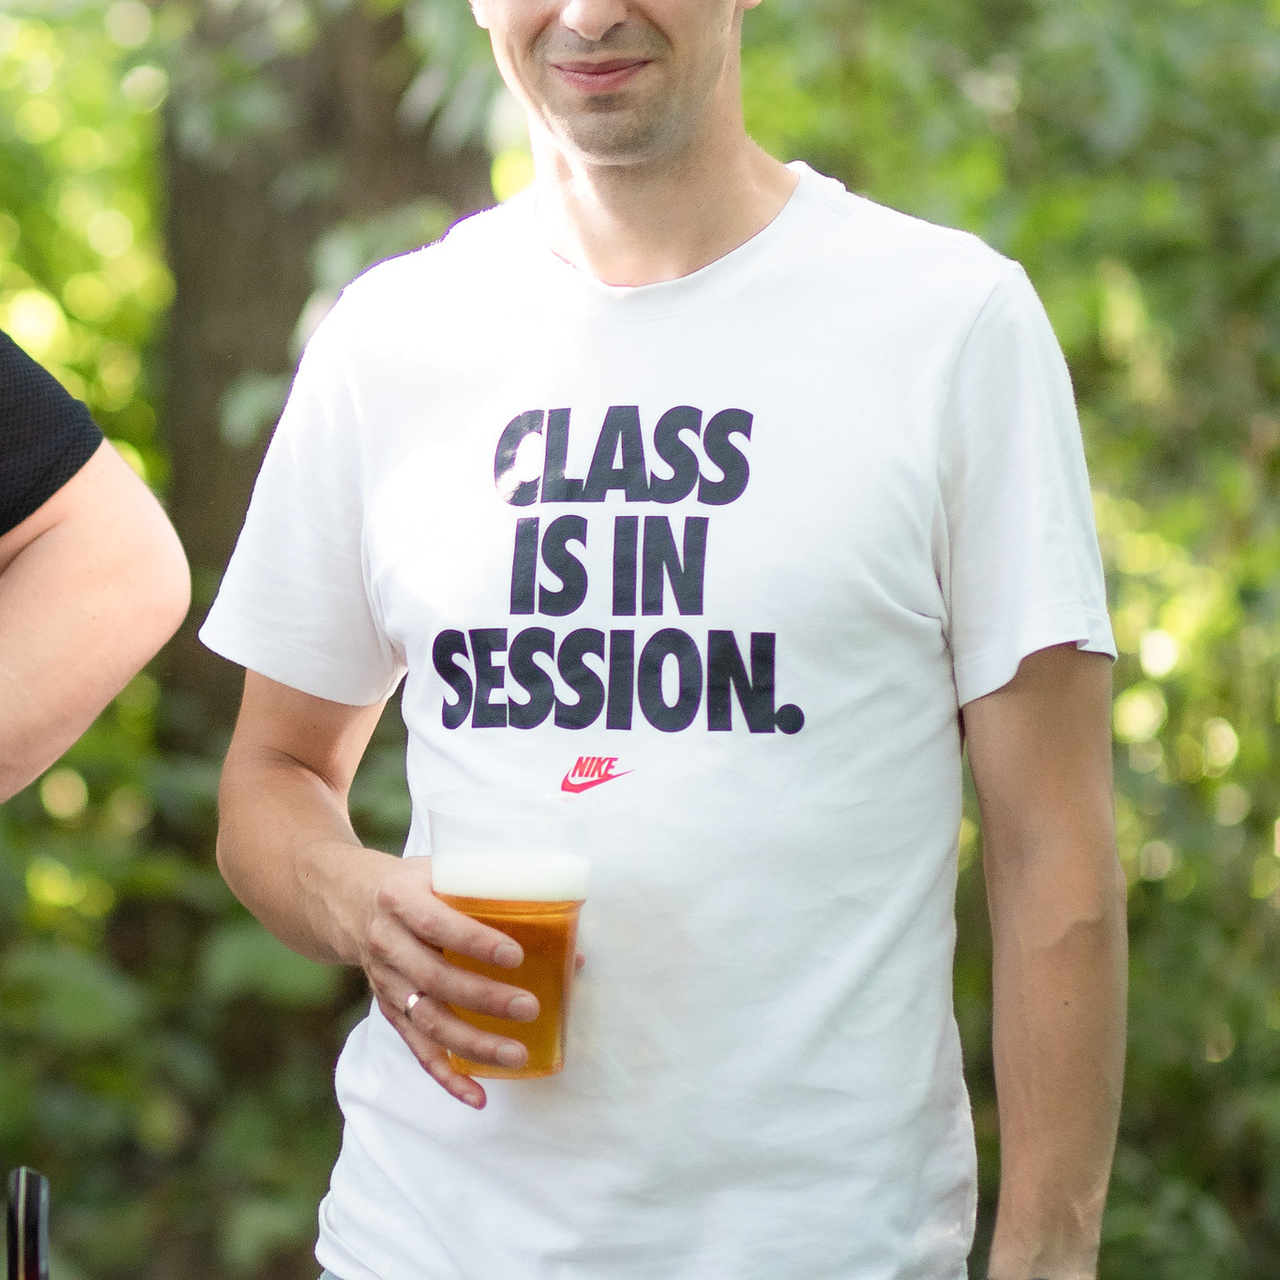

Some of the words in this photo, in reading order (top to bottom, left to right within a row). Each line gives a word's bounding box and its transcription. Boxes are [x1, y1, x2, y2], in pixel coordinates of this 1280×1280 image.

[494, 405, 754, 507] CLASS
[510, 515, 589, 617] IS
[611, 516, 709, 617] IN
[432, 626, 806, 736] SESSION.
[571, 756, 619, 779] NIKE
